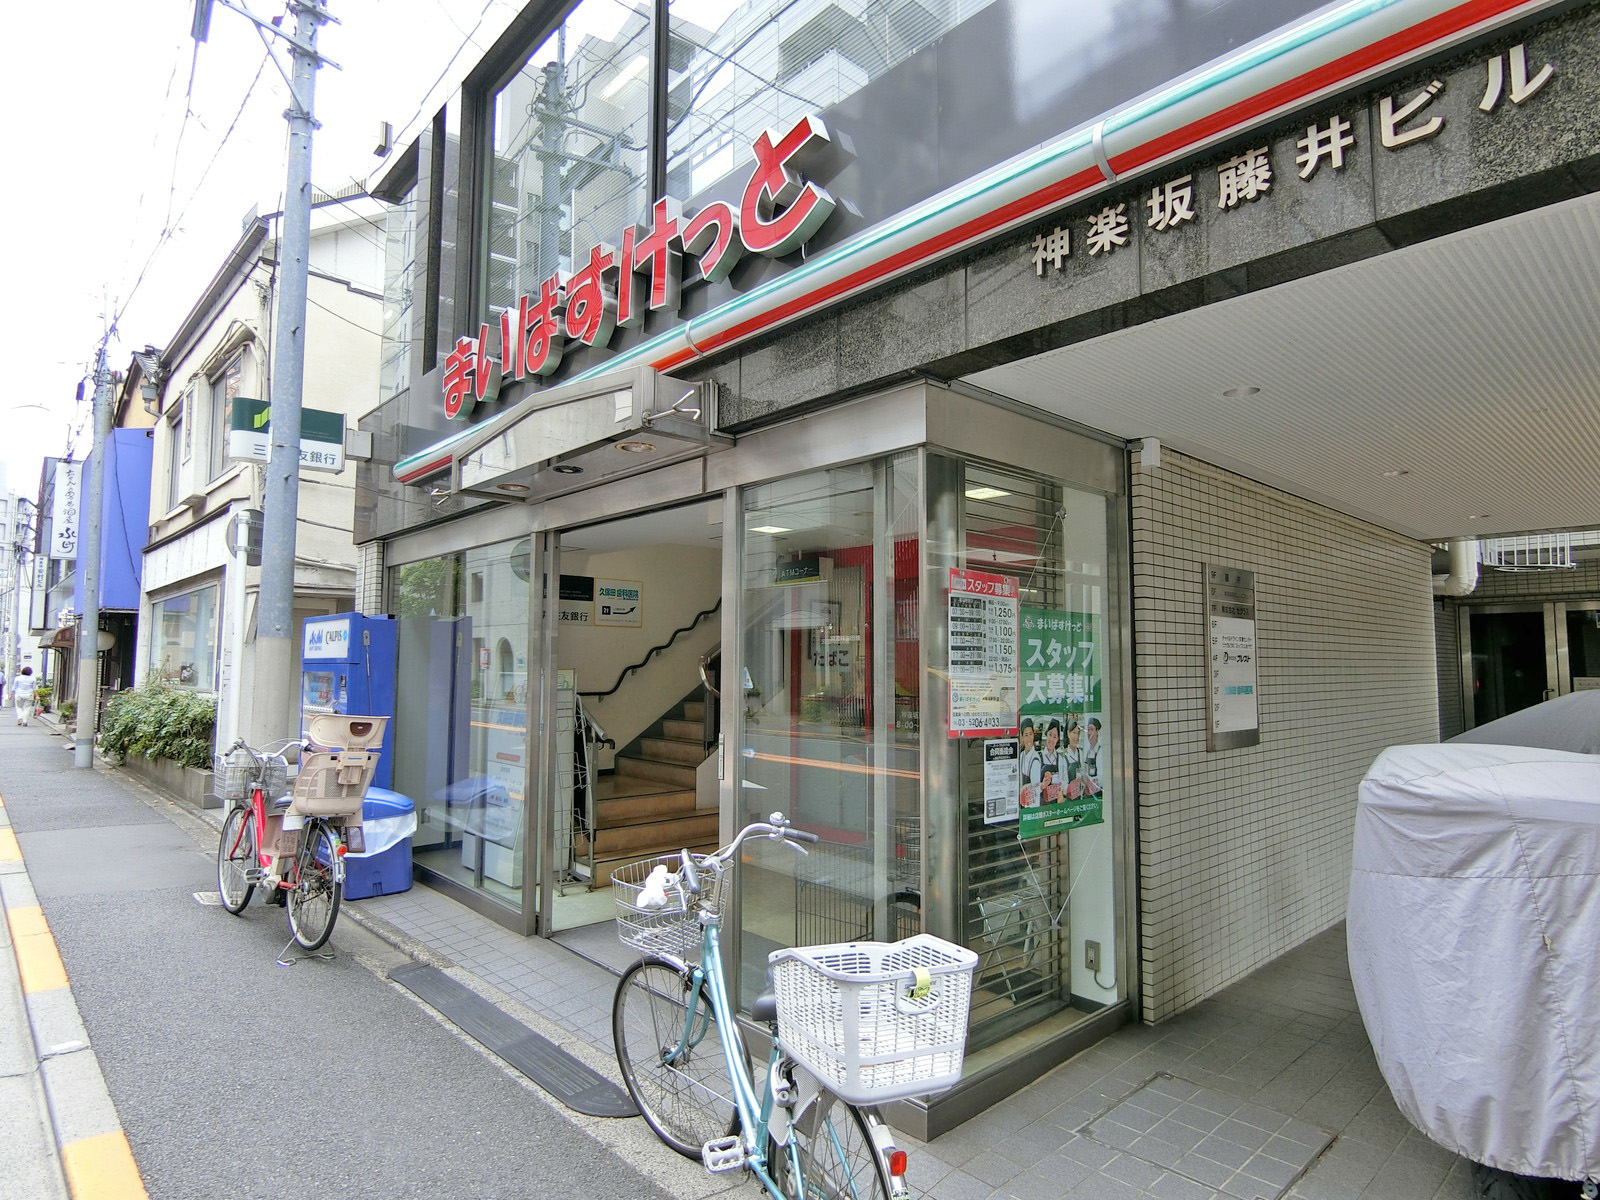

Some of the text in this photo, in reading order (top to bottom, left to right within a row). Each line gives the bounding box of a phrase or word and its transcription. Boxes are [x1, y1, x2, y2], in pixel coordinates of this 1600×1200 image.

[1031, 43, 1556, 277] 神楽坂藤井ビル
[442, 112, 837, 421] まいばすけっと
[1036, 618, 1082, 633] まいばすけっと
[1026, 638, 1094, 669] スタッフ
[1026, 672, 1094, 705] 大募集!!
